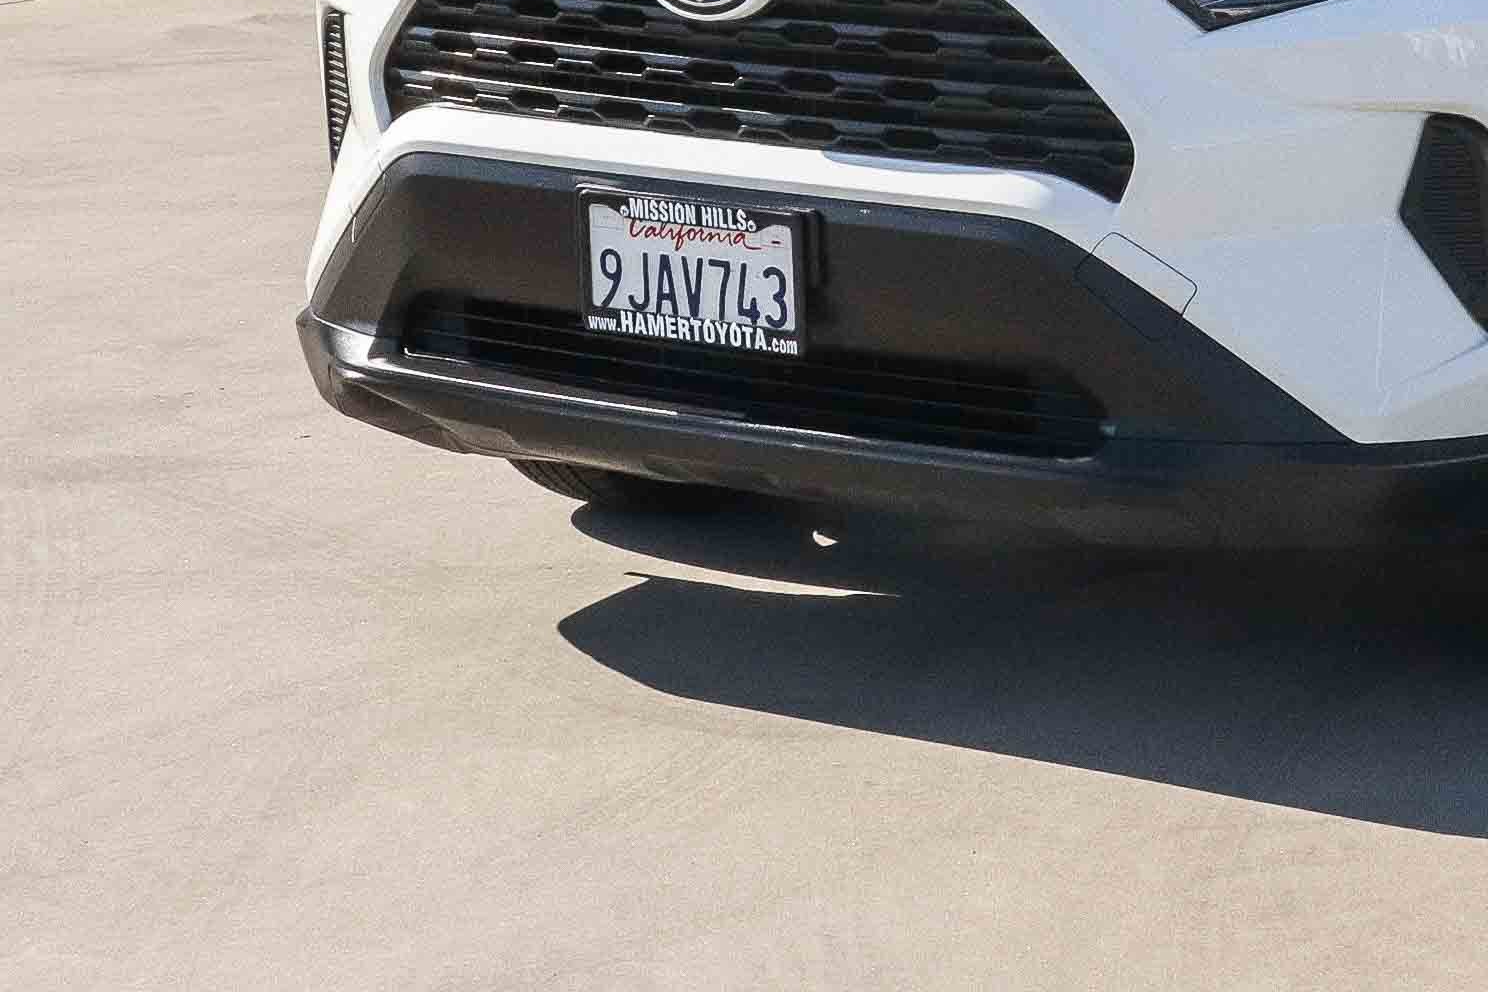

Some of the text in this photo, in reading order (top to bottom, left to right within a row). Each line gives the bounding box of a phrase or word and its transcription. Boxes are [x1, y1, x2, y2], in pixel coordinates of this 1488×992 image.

[628, 197, 748, 231] MISSION HILLS
[628, 219, 763, 251] California
[600, 247, 789, 330] 9JAV743
[587, 310, 798, 356] www.HAMERTOYOTA.com
